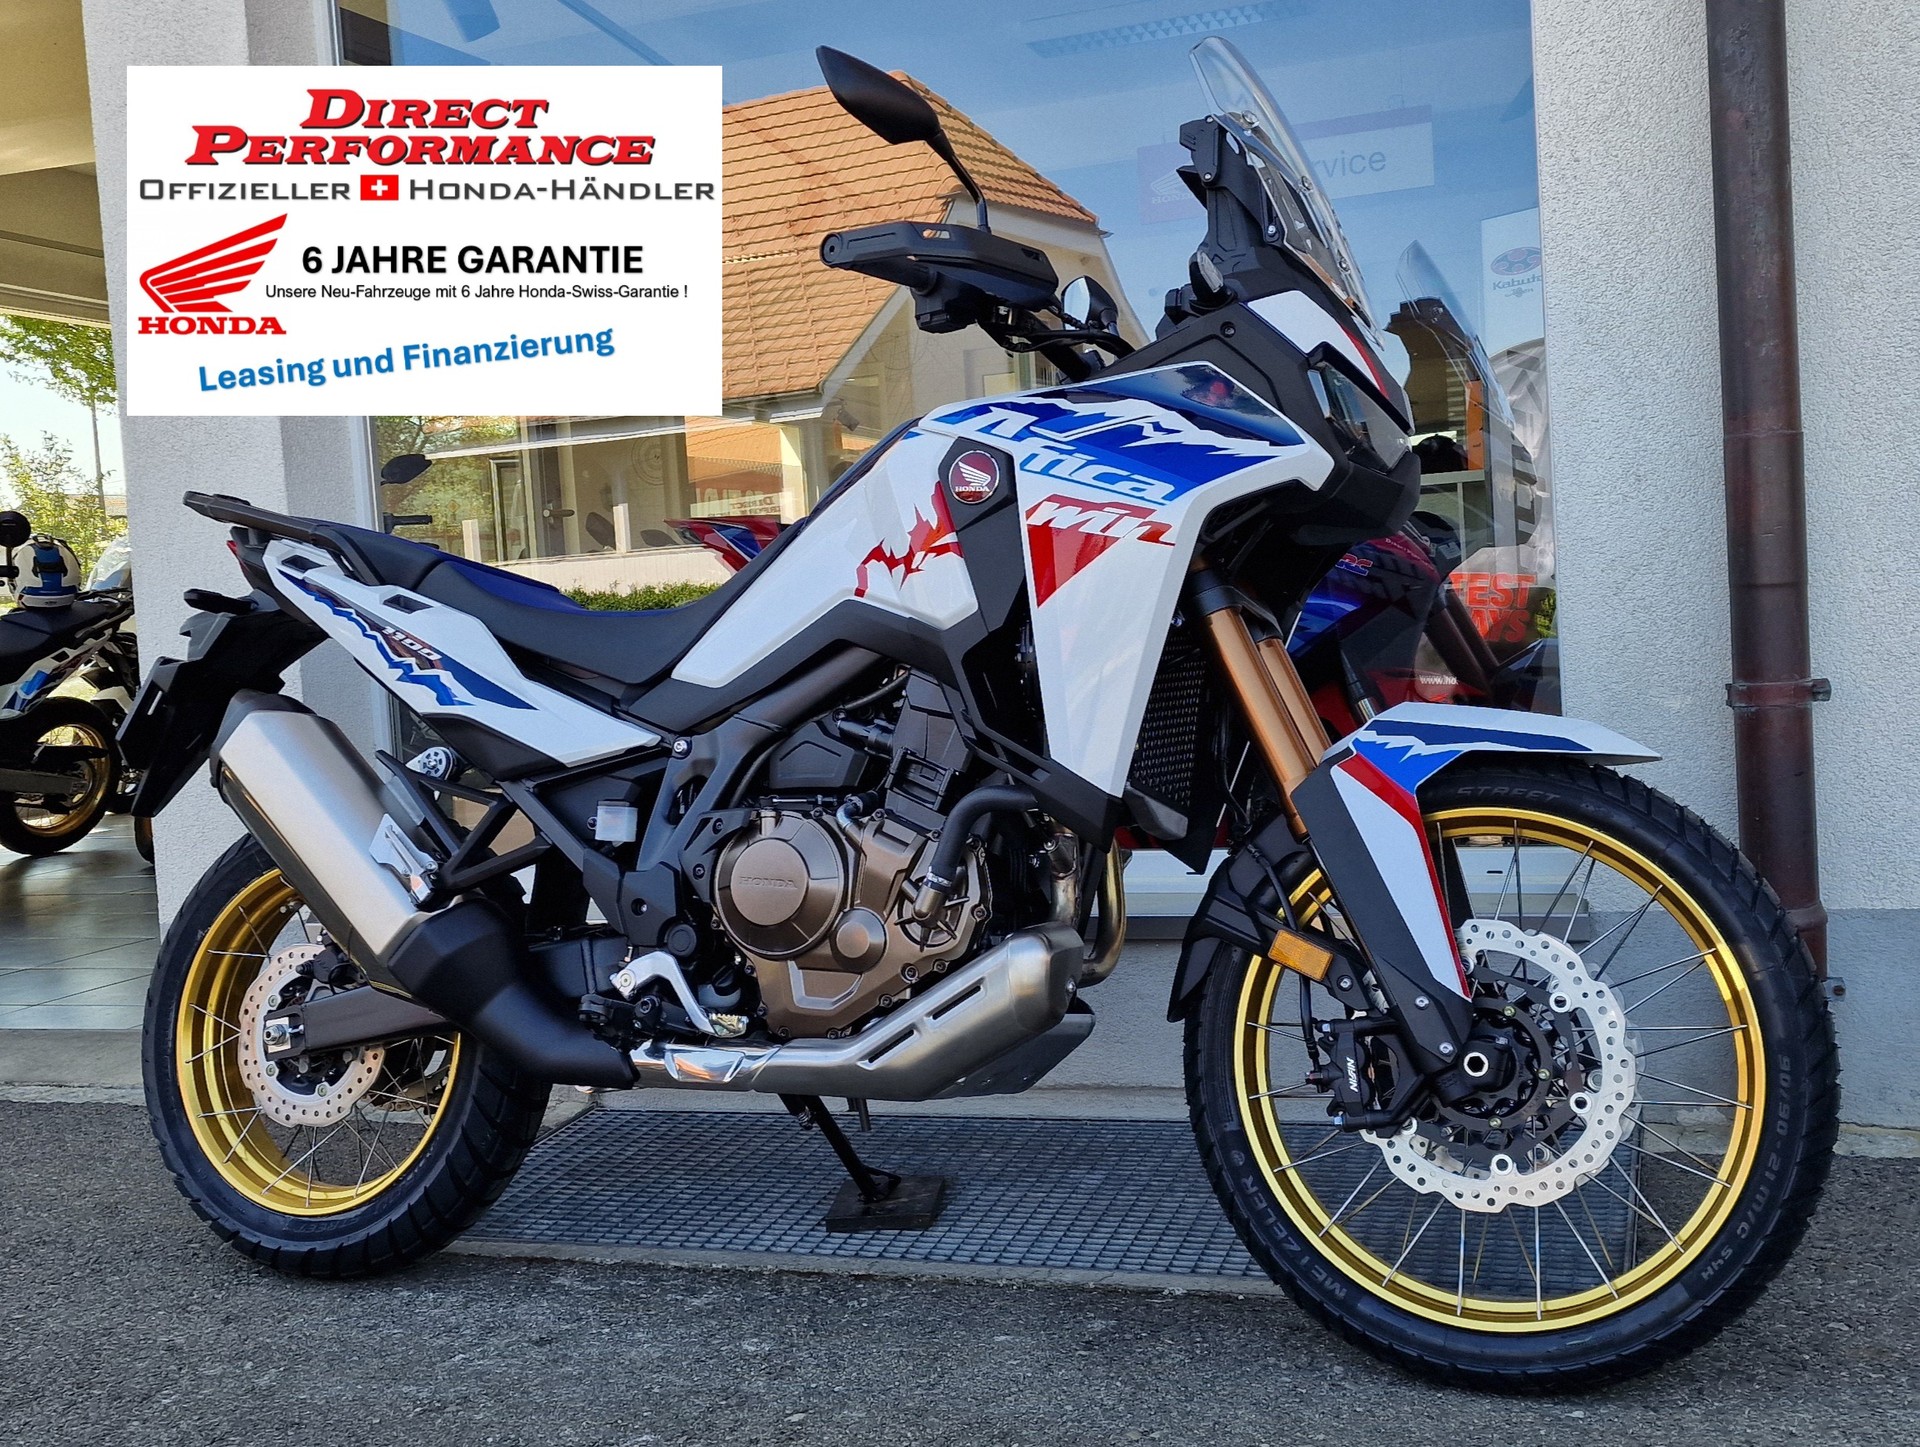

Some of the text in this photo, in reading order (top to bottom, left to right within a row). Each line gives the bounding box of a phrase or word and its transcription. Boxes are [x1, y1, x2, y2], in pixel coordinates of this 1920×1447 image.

[1449, 572, 1537, 608] TEST
[382, 625, 443, 661] 1100
[1470, 607, 1531, 643] AYS
[1457, 786, 1560, 802] STREET
[739, 876, 797, 889] HONDA
[1241, 1174, 1349, 1299] METZELER
